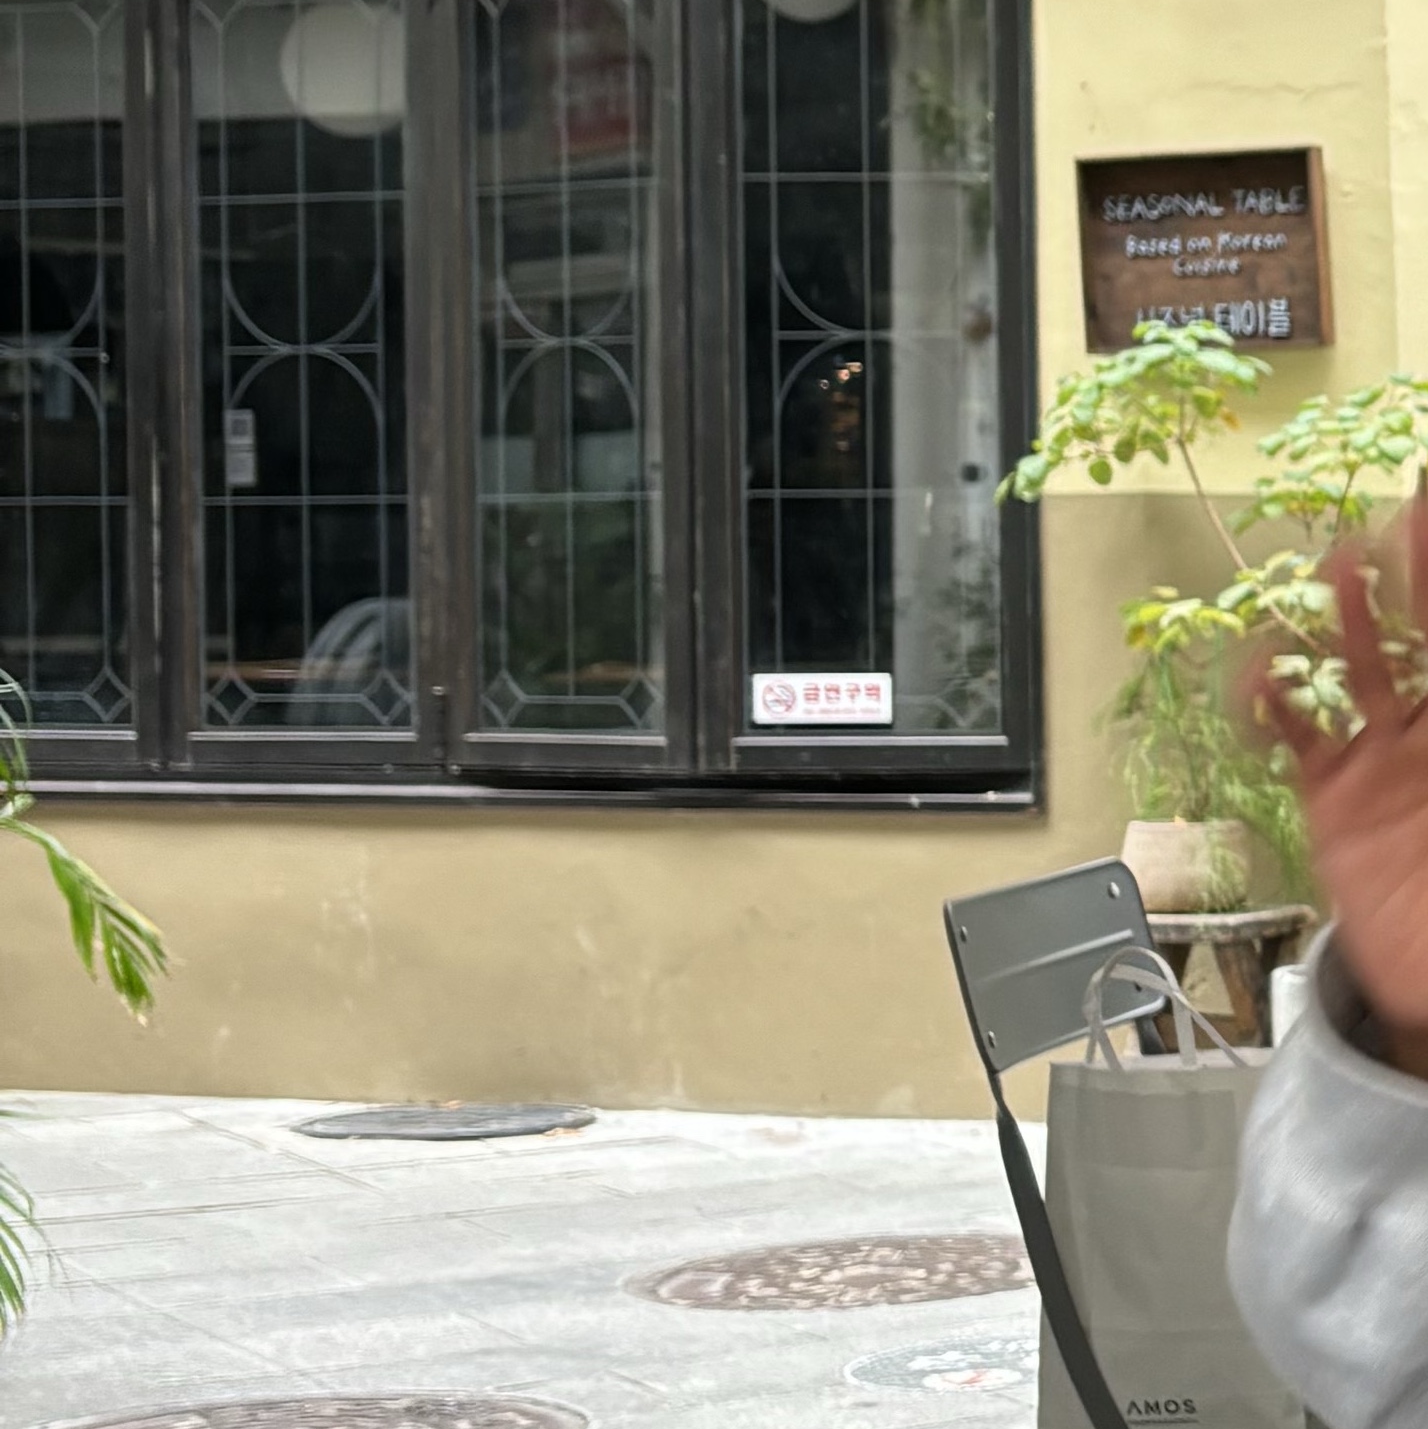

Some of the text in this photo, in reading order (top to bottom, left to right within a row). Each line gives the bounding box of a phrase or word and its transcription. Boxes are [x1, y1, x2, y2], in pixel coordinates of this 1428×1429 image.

[1103, 185, 1305, 222] SEASONAL TABLE
[1126, 233, 1183, 259] Based
[1186, 234, 1213, 253] on
[803, 682, 882, 704] 금연구역
[1127, 1398, 1197, 1415] AMOS
